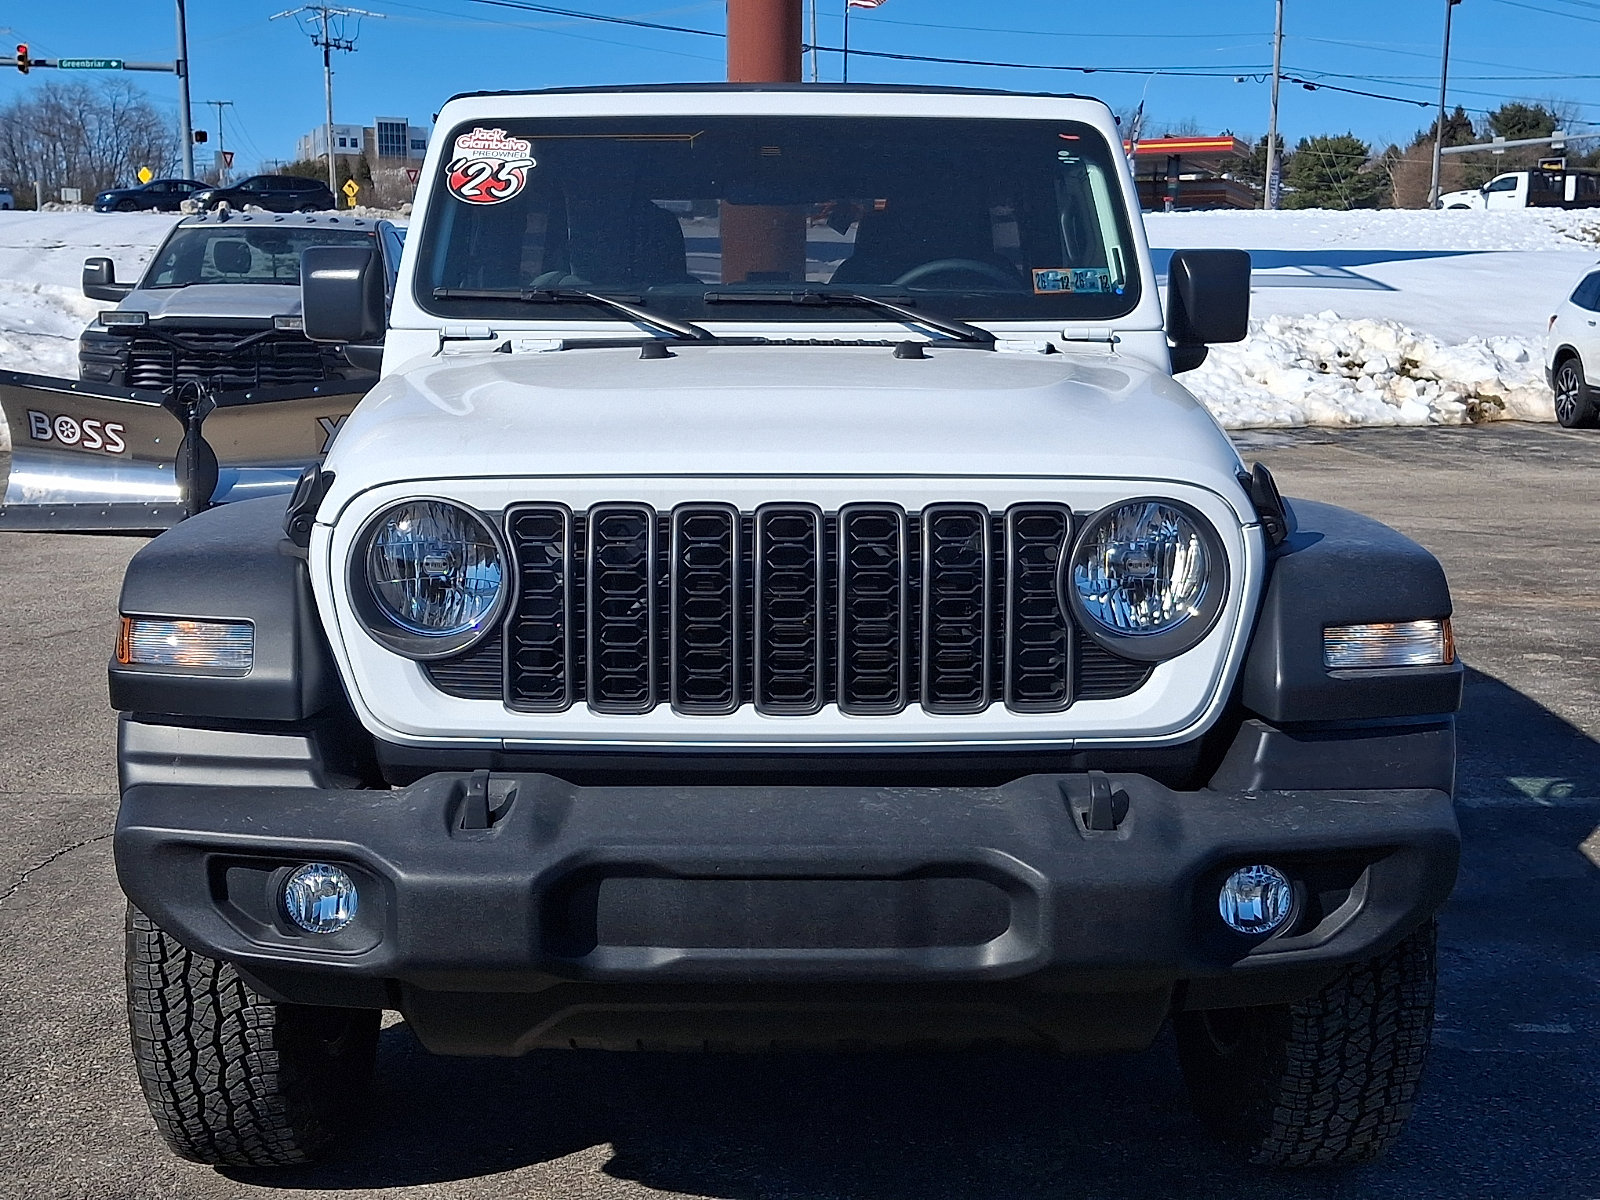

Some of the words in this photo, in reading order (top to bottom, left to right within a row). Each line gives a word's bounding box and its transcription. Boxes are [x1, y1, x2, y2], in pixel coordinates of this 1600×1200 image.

[62, 60, 106, 68] Greenbriar
[472, 128, 507, 142] Jack
[472, 150, 527, 158] PREOWNED
[28, 410, 125, 454] BOSS
